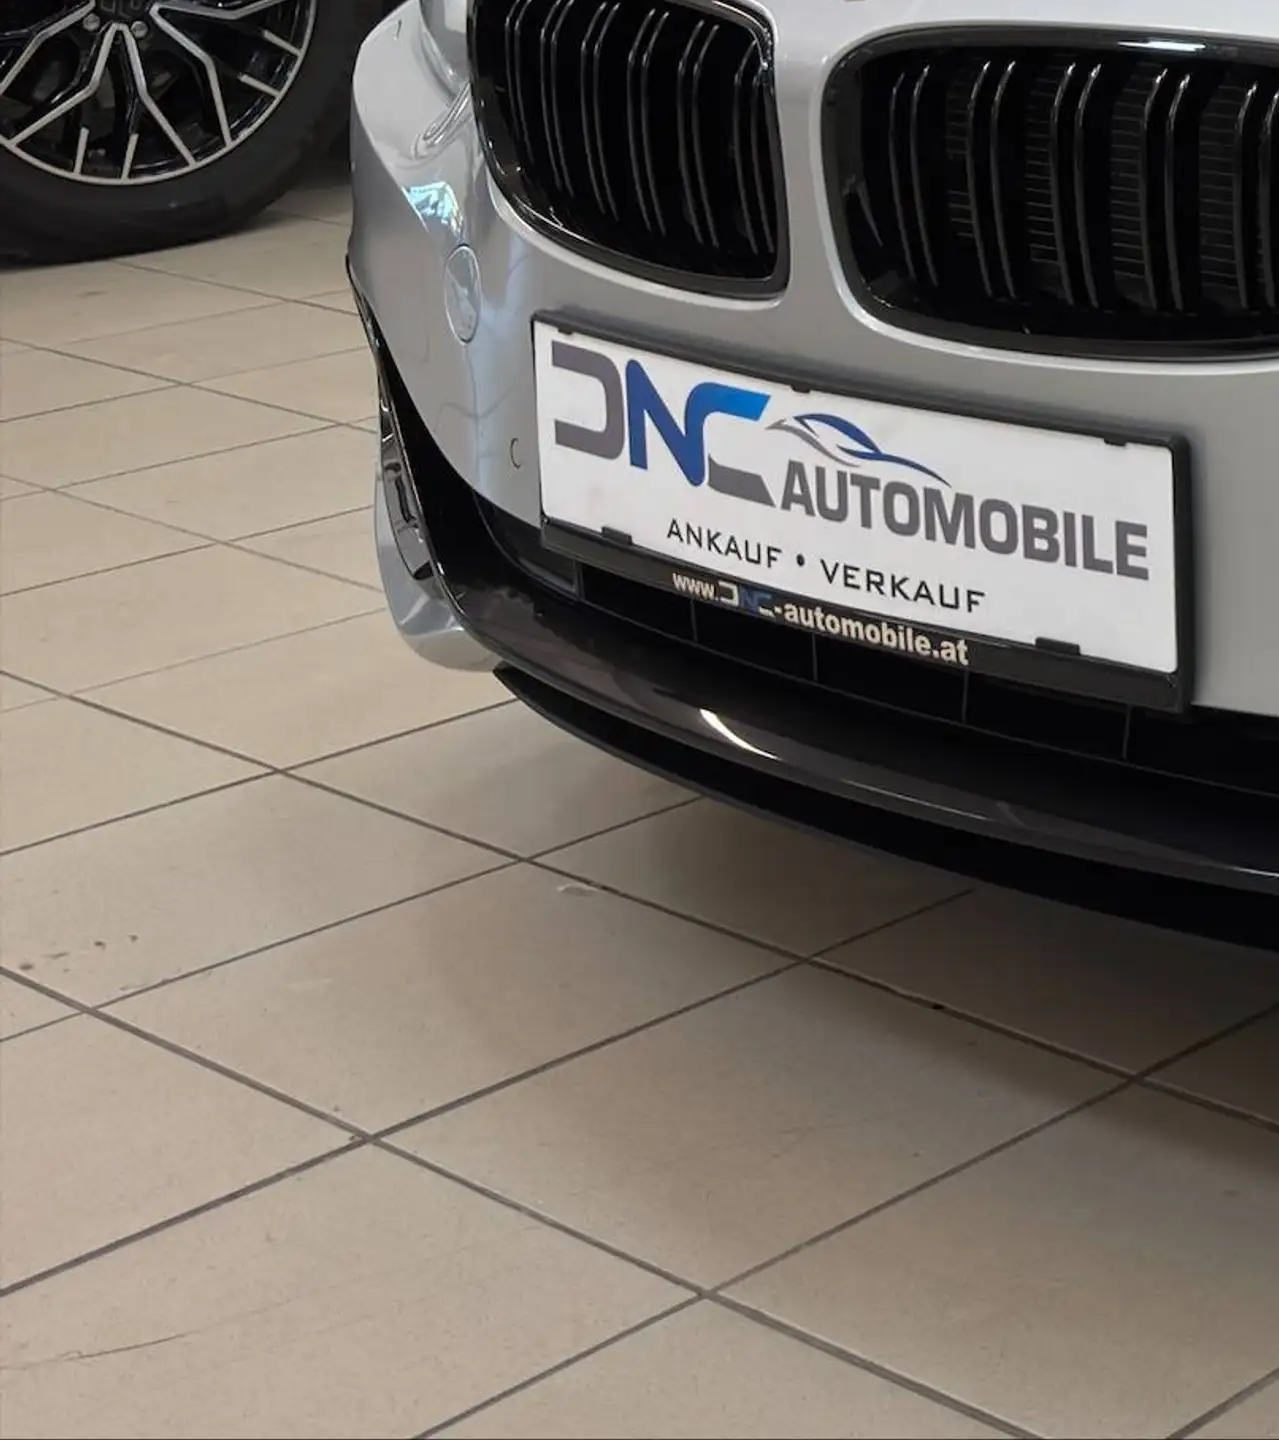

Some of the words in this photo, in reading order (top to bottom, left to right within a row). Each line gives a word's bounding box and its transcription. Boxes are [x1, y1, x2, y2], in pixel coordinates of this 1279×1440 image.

[551, 340, 776, 507] DNC
[666, 517, 783, 570] ANKAUF
[819, 558, 986, 614] VERKAUF
[780, 459, 1150, 581] AUTOMOBILE
